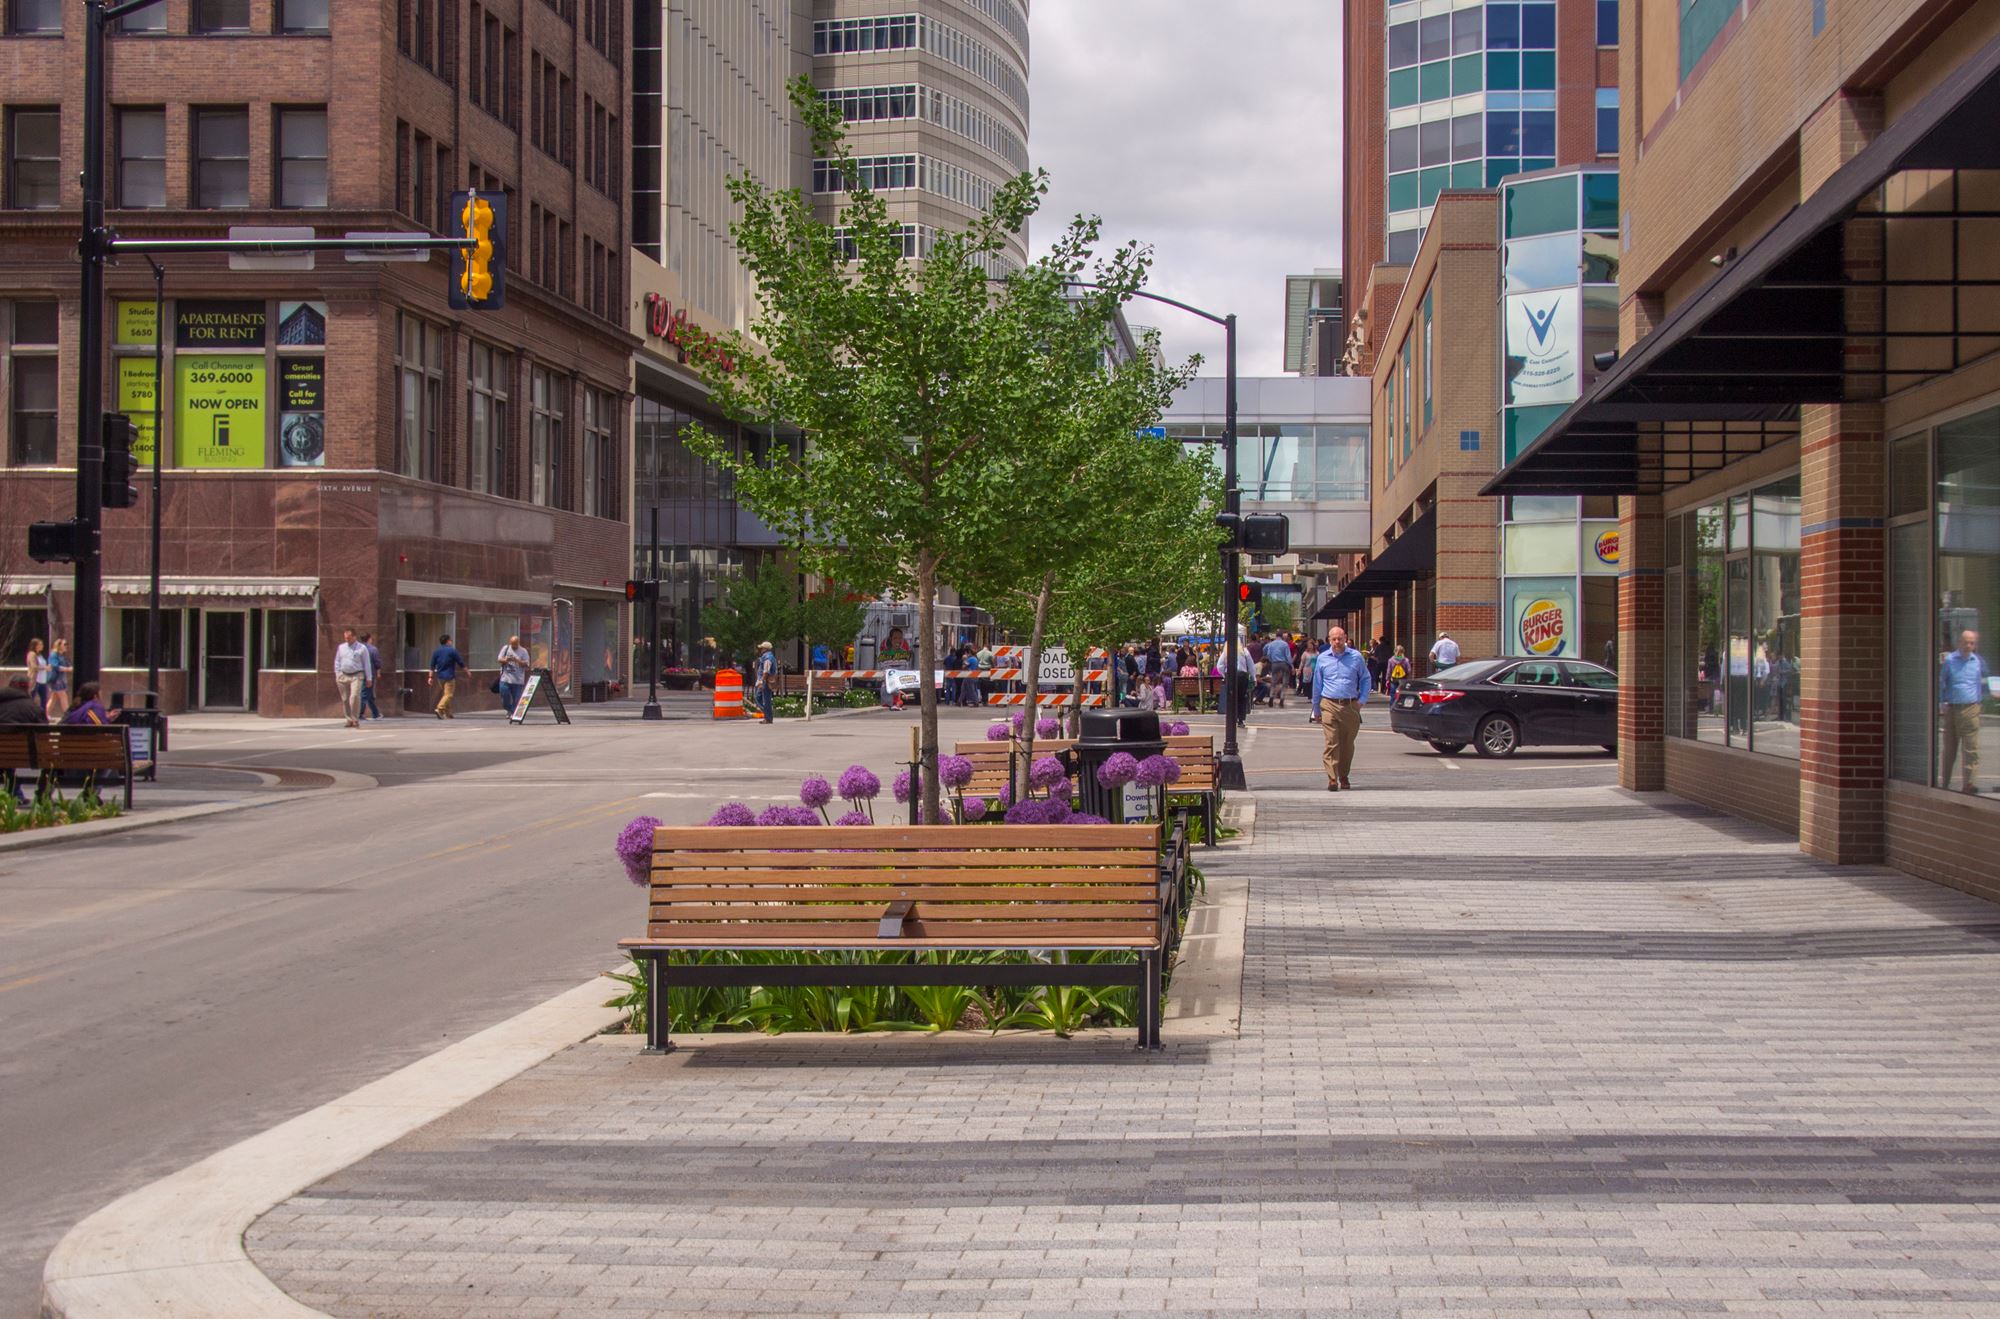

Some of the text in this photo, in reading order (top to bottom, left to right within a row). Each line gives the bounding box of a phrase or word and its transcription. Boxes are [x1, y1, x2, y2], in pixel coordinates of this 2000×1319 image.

[128, 307, 155, 316] Studio
[179, 313, 265, 324] APARTMENTS
[131, 329, 153, 337] $650
[190, 327, 257, 338] FOR RENT
[192, 361, 209, 370] Call
[245, 361, 254, 370] at
[291, 363, 314, 371] Great
[128, 370, 156, 378] Bedroo
[190, 372, 253, 383] 369.6000
[284, 372, 321, 380] amenities
[131, 391, 153, 399] $780
[288, 390, 317, 398] Call for
[189, 399, 258, 410] NOW OPEN
[198, 447, 245, 457] FLEMING
[1598, 536, 1619, 548] BURG
[1599, 543, 1619, 556] KIN
[1523, 608, 1563, 632] BURGER
[1524, 619, 1564, 648] KING
[1040, 653, 1069, 664] OAD
[1037, 667, 1076, 679] OSED
